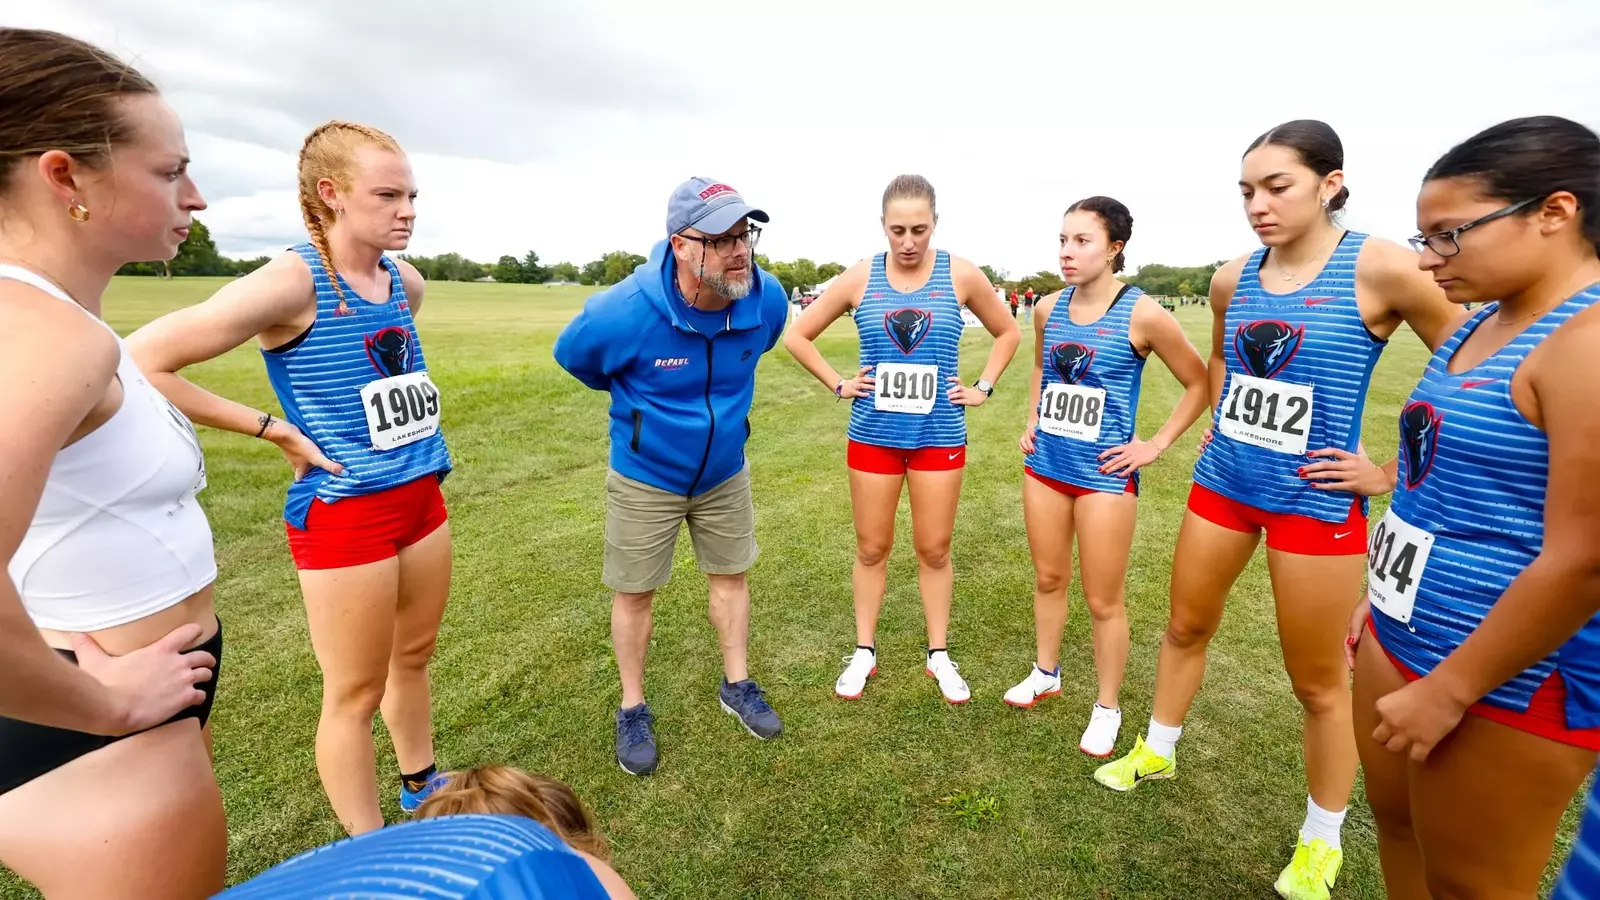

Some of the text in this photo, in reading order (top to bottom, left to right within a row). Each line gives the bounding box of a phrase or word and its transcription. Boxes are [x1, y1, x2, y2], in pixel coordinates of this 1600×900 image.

[880, 371, 934, 400] 1910
[370, 382, 438, 433] 1909
[1043, 391, 1100, 427] 1908
[1225, 385, 1309, 436] 1912
[392, 424, 432, 442] LAKESHORE
[1234, 429, 1283, 446] LAKESHORE
